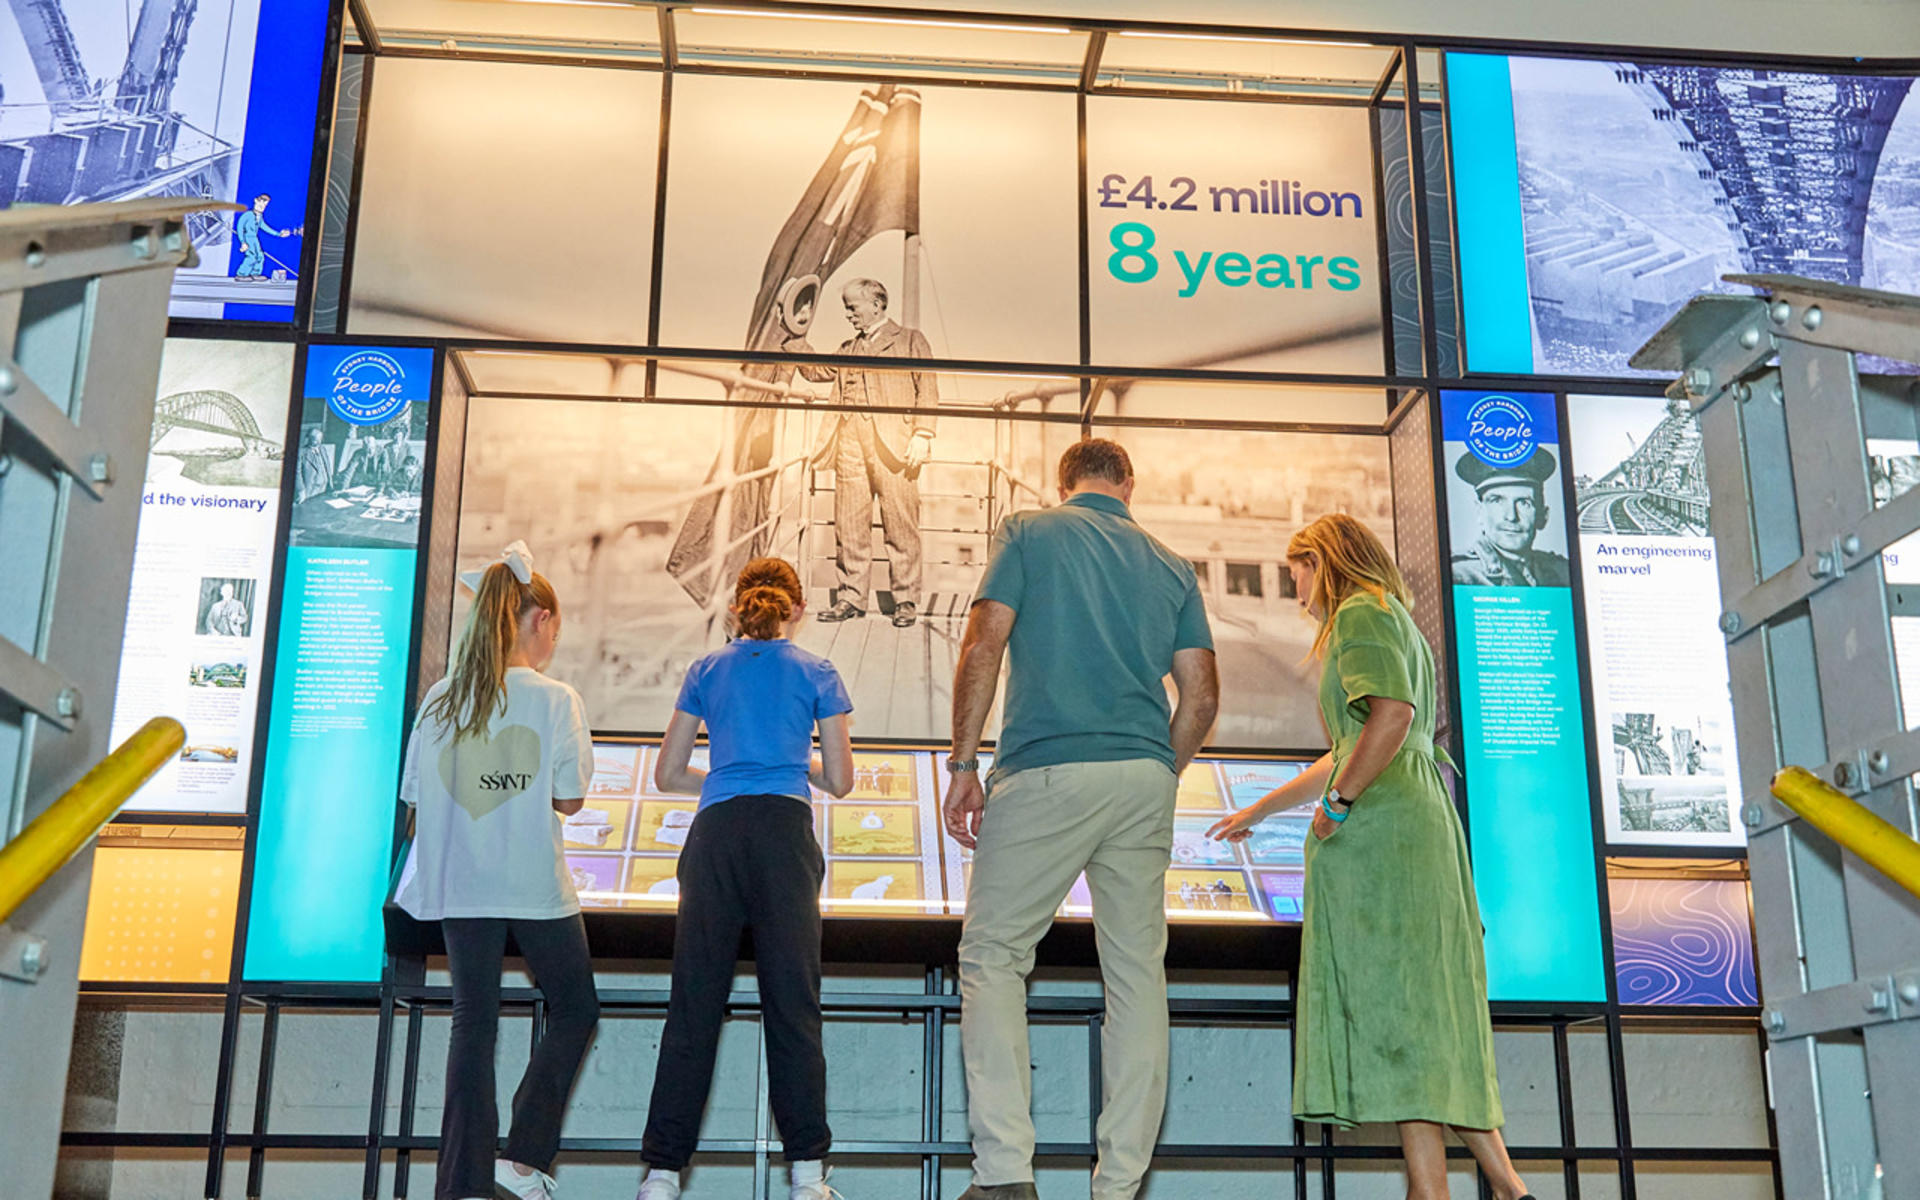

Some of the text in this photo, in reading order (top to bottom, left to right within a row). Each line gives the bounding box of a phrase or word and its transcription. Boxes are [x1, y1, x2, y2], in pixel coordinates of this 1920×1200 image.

[1098, 174, 1363, 218] £4.2 million
[1108, 222, 1361, 298] 8 years
[333, 376, 402, 398] People
[337, 394, 396, 416] OF THE BRIDGE
[1469, 420, 1533, 442] People
[159, 493, 186, 507] the
[191, 494, 267, 513] visionary
[1597, 543, 1712, 562] An engineering
[1598, 563, 1651, 576] marvel
